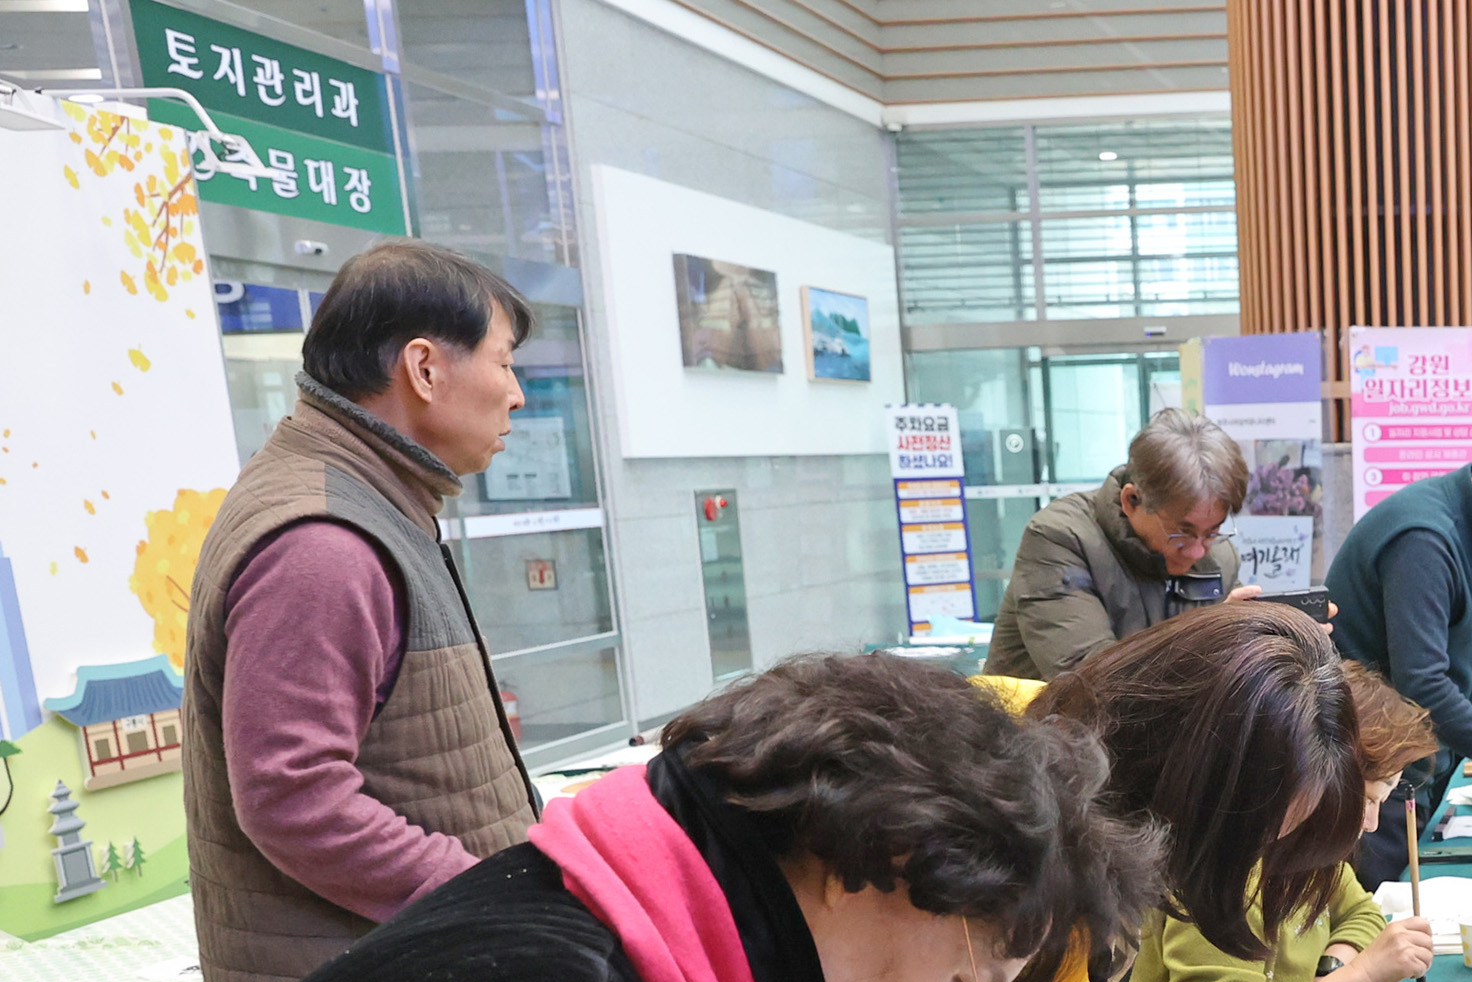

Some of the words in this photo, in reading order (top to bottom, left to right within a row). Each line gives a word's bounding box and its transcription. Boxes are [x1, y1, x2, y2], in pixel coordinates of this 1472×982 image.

[164, 28, 359, 127] 토지관리과
[1408, 354, 1450, 376] 강원
[895, 416, 949, 432] 주차요금
[897, 435, 952, 452] 사전정산
